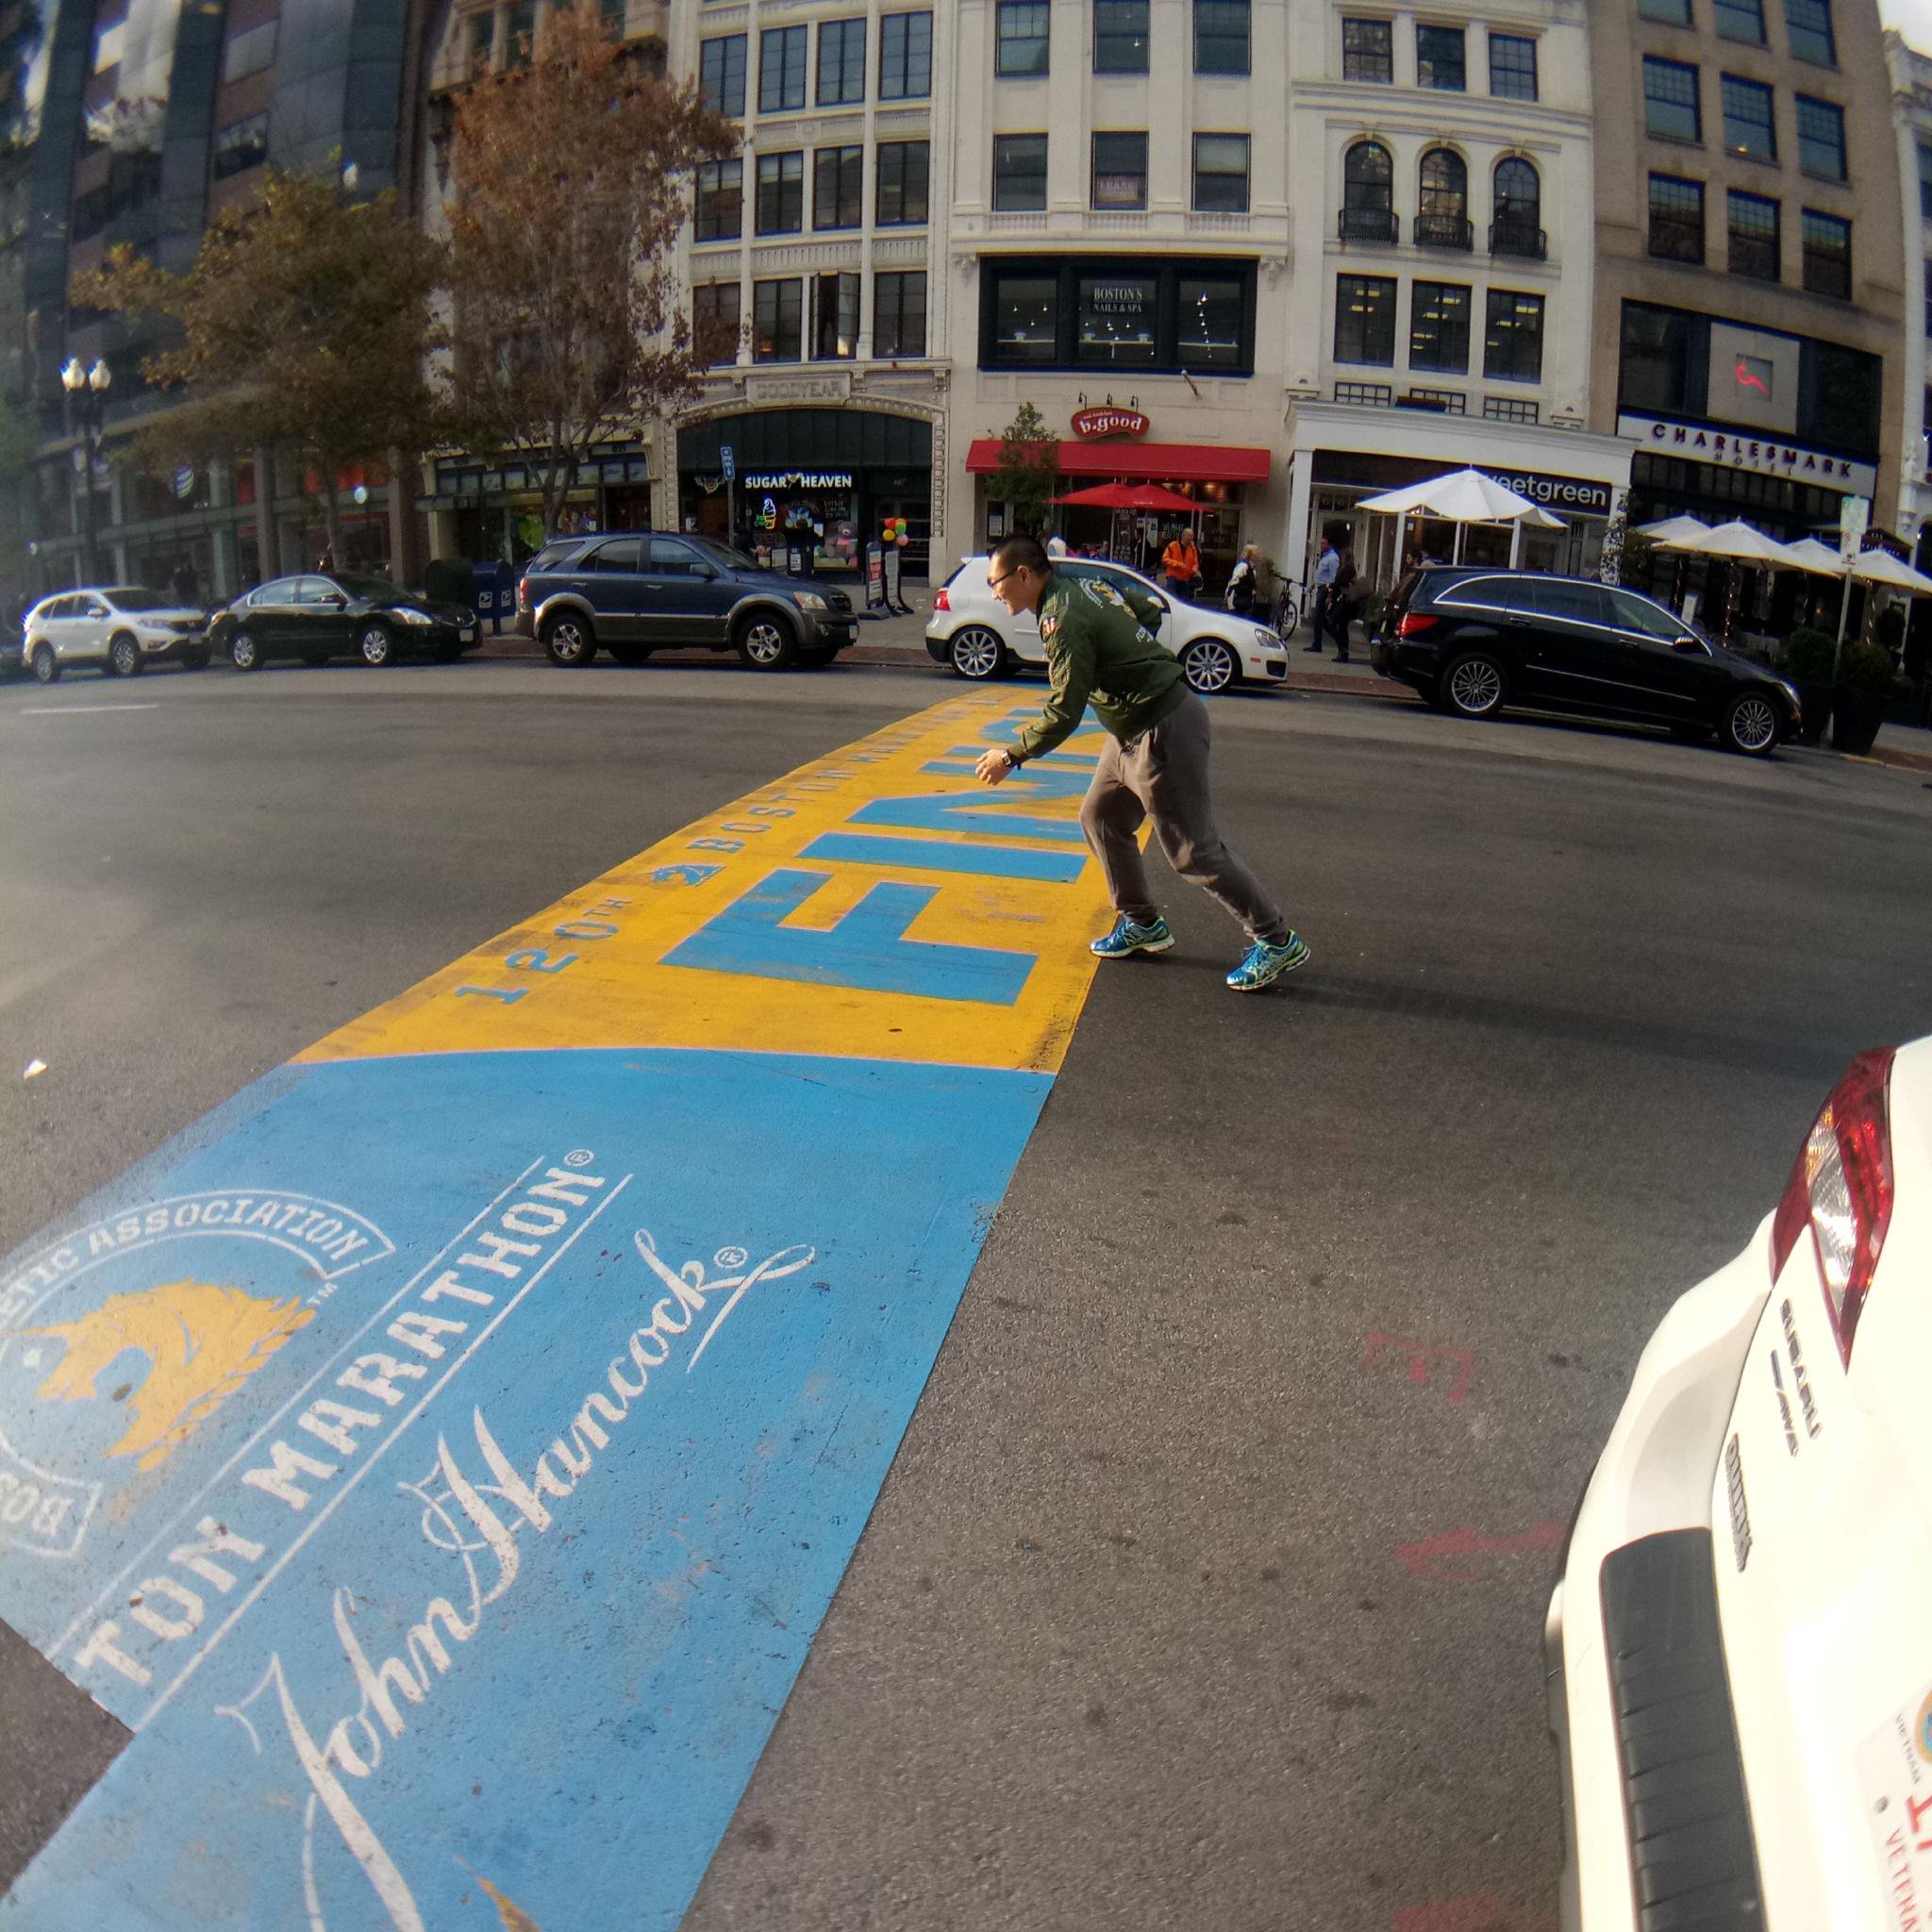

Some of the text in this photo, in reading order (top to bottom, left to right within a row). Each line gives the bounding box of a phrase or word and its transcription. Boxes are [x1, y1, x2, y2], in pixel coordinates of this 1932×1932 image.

[1094, 287, 1143, 300] BOSTON'S
[1094, 303, 1117, 312] NAILS
[1127, 303, 1142, 312] SPA
[1078, 416, 1142, 434] b.good
[1652, 424, 1853, 478] CHARLESMARK
[744, 475, 852, 489] SUGAR HEAVEN
[686, 769, 858, 854] BOSTON
[89, 1198, 369, 1262] ASSOCIATION
[213, 1587, 479, 1932] John
[1886, 1827, 1919, 1932] VETERA
